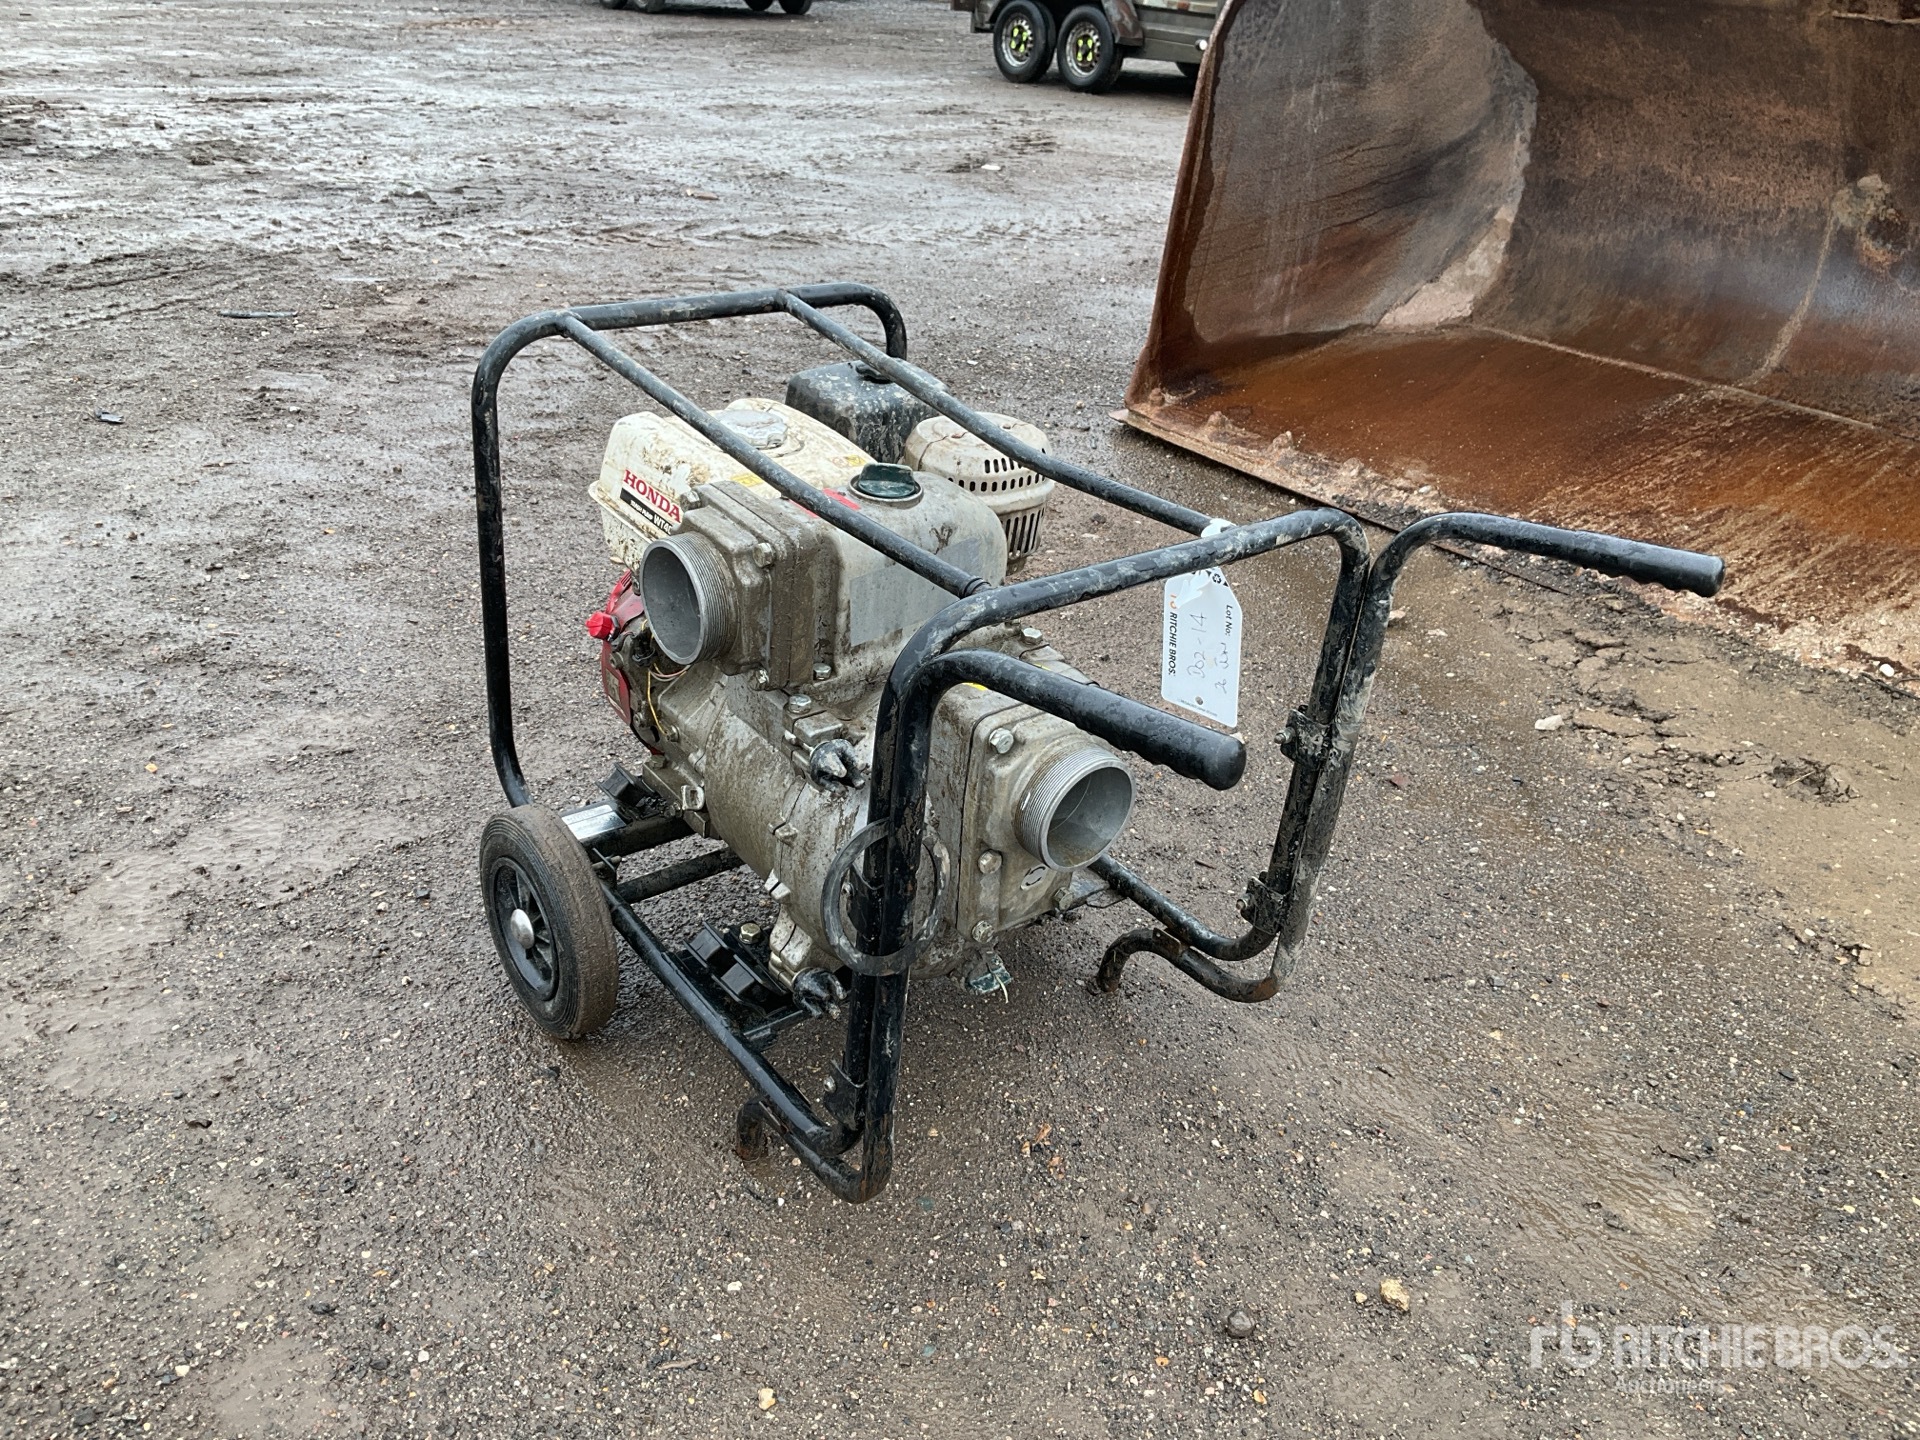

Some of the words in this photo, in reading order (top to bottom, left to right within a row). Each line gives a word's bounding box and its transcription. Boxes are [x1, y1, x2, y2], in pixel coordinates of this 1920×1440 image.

[623, 469, 681, 523] HONDA
[1169, 612, 1178, 649] RITCHIE
[1225, 604, 1233, 620] Lot
